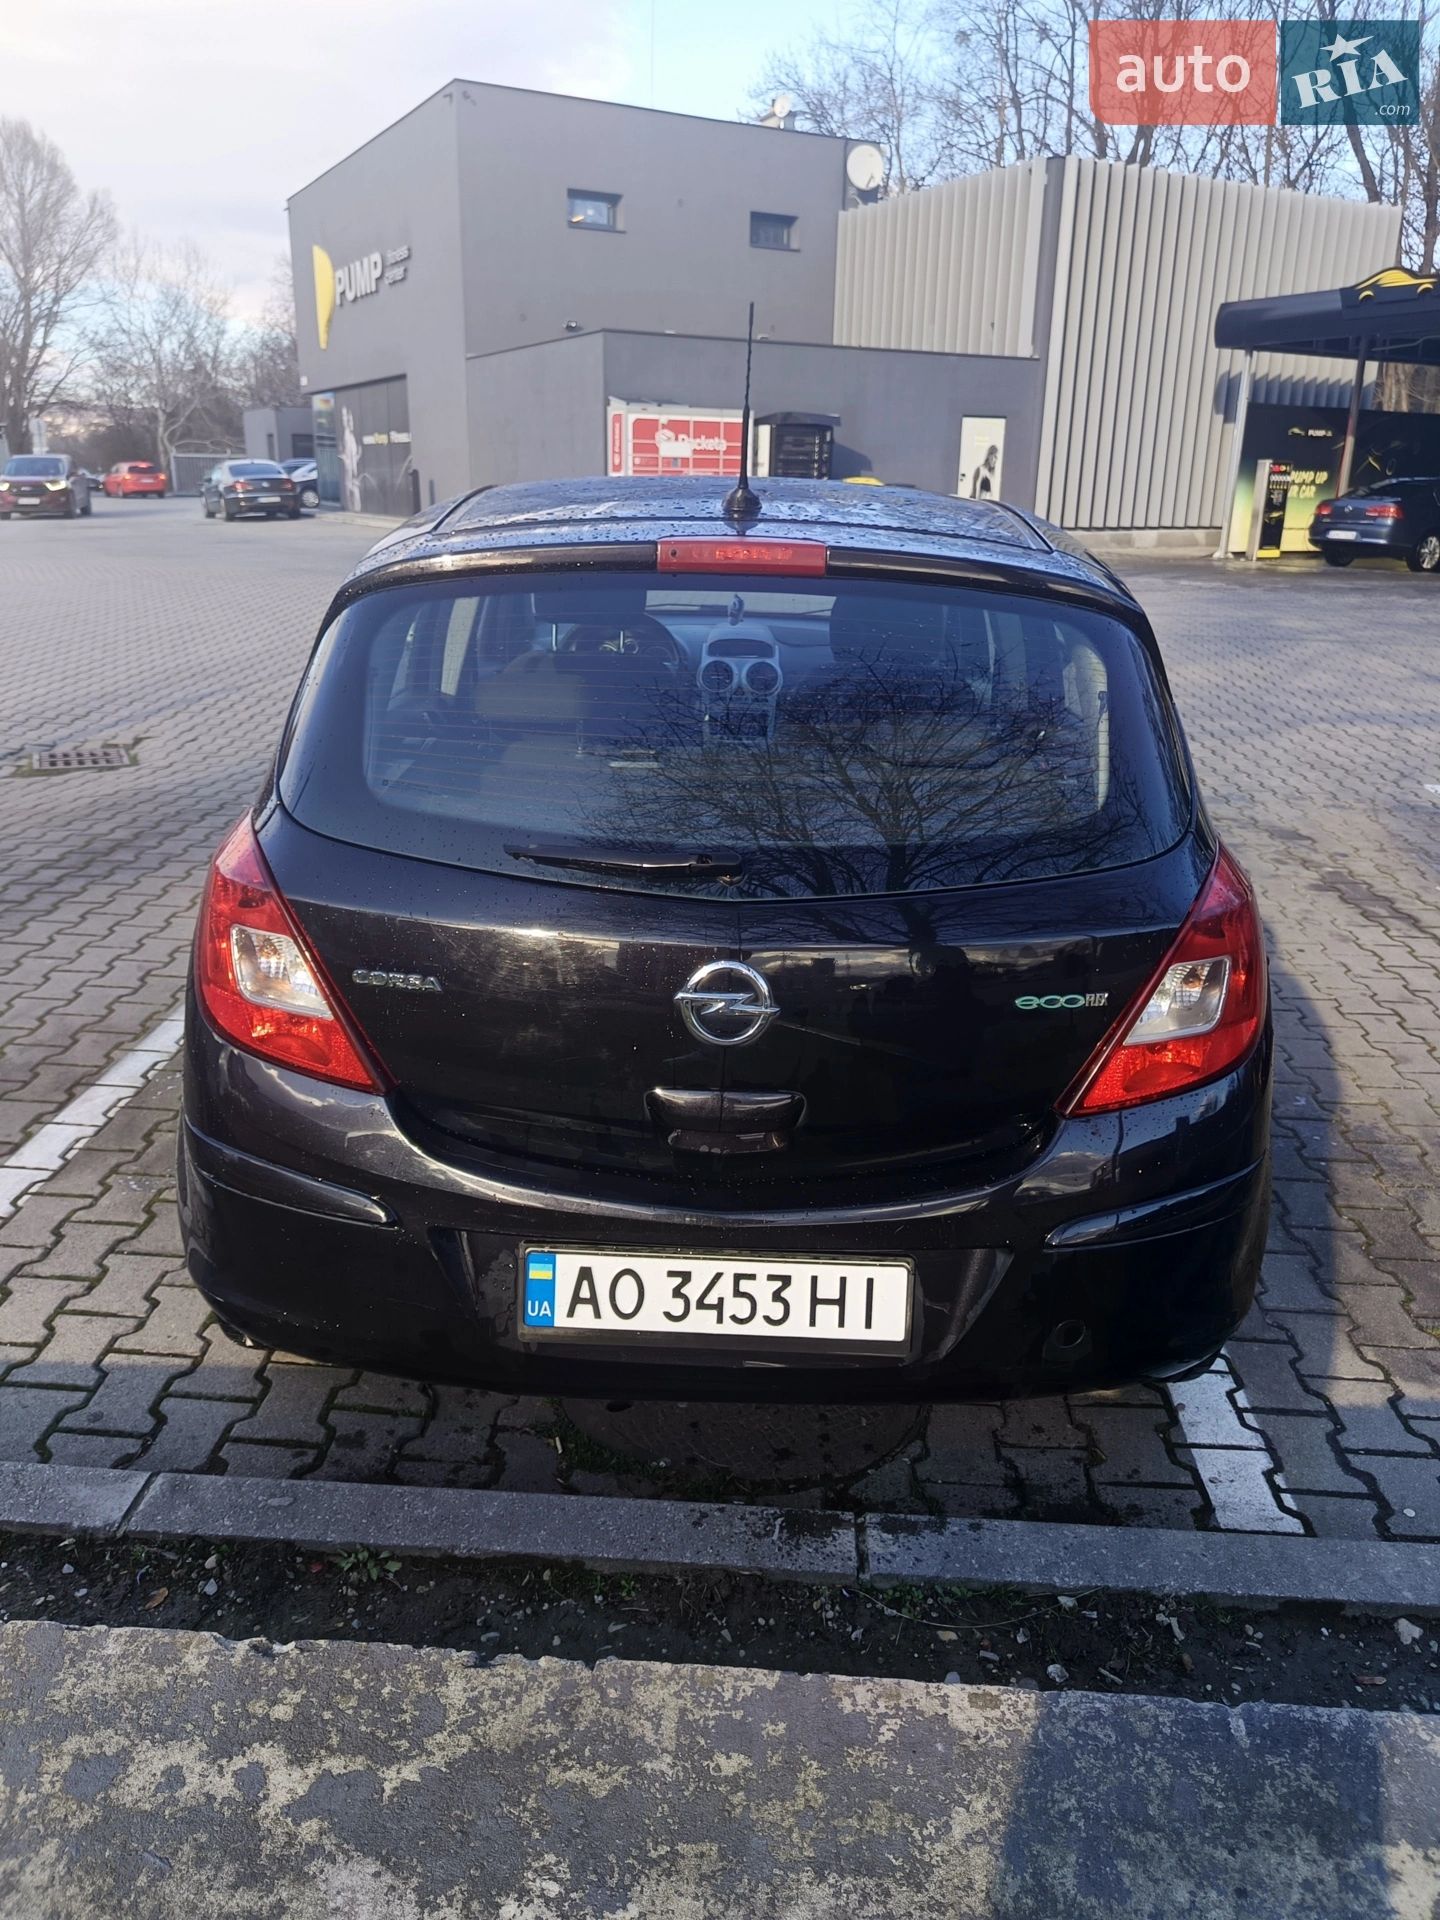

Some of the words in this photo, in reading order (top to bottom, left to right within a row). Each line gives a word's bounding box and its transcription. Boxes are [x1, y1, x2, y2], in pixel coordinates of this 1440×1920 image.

[335, 252, 383, 306] PUMP
[1315, 470, 1329, 485] UP
[1299, 485, 1317, 499] CAR
[352, 969, 443, 993] CORSA
[566, 1266, 645, 1320] AO
[662, 1270, 792, 1327] 3453
[809, 1275, 874, 1329] HI
[527, 1300, 552, 1317] UA
